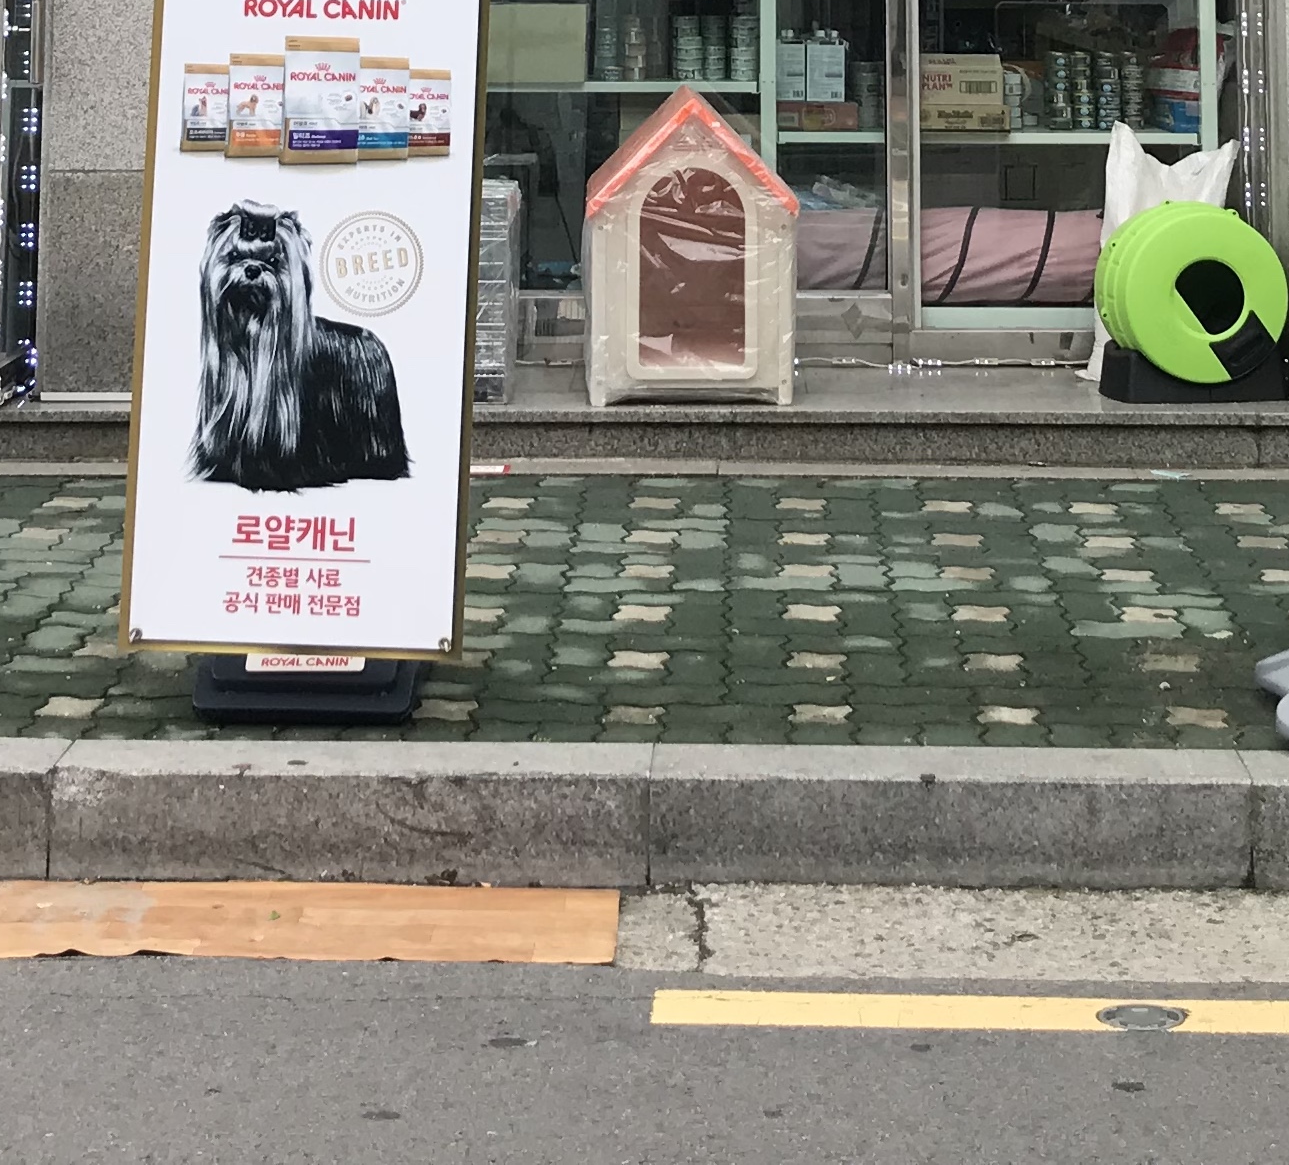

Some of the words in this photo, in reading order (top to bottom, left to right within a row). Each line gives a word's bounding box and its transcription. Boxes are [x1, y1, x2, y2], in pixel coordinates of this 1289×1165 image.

[290, 72, 322, 81] ROYAL
[324, 72, 356, 82] CANIN
[922, 74, 952, 82] NUTRI
[210, 87, 228, 95] CANI
[233, 82, 258, 91] ROYAL
[360, 85, 379, 93] OYAL
[337, 224, 386, 250] EXPERTS
[334, 247, 409, 279] BREED
[345, 278, 406, 303] NUTRITION
[231, 515, 356, 553] 로얄캐닌
[246, 566, 299, 588] 견종별
[305, 569, 342, 589] 사료
[223, 592, 259, 614] 공식
[265, 593, 301, 615] 판매
[307, 595, 361, 617] 전문점
[261, 657, 302, 667] ROYAL
[305, 656, 349, 667] CANIN
